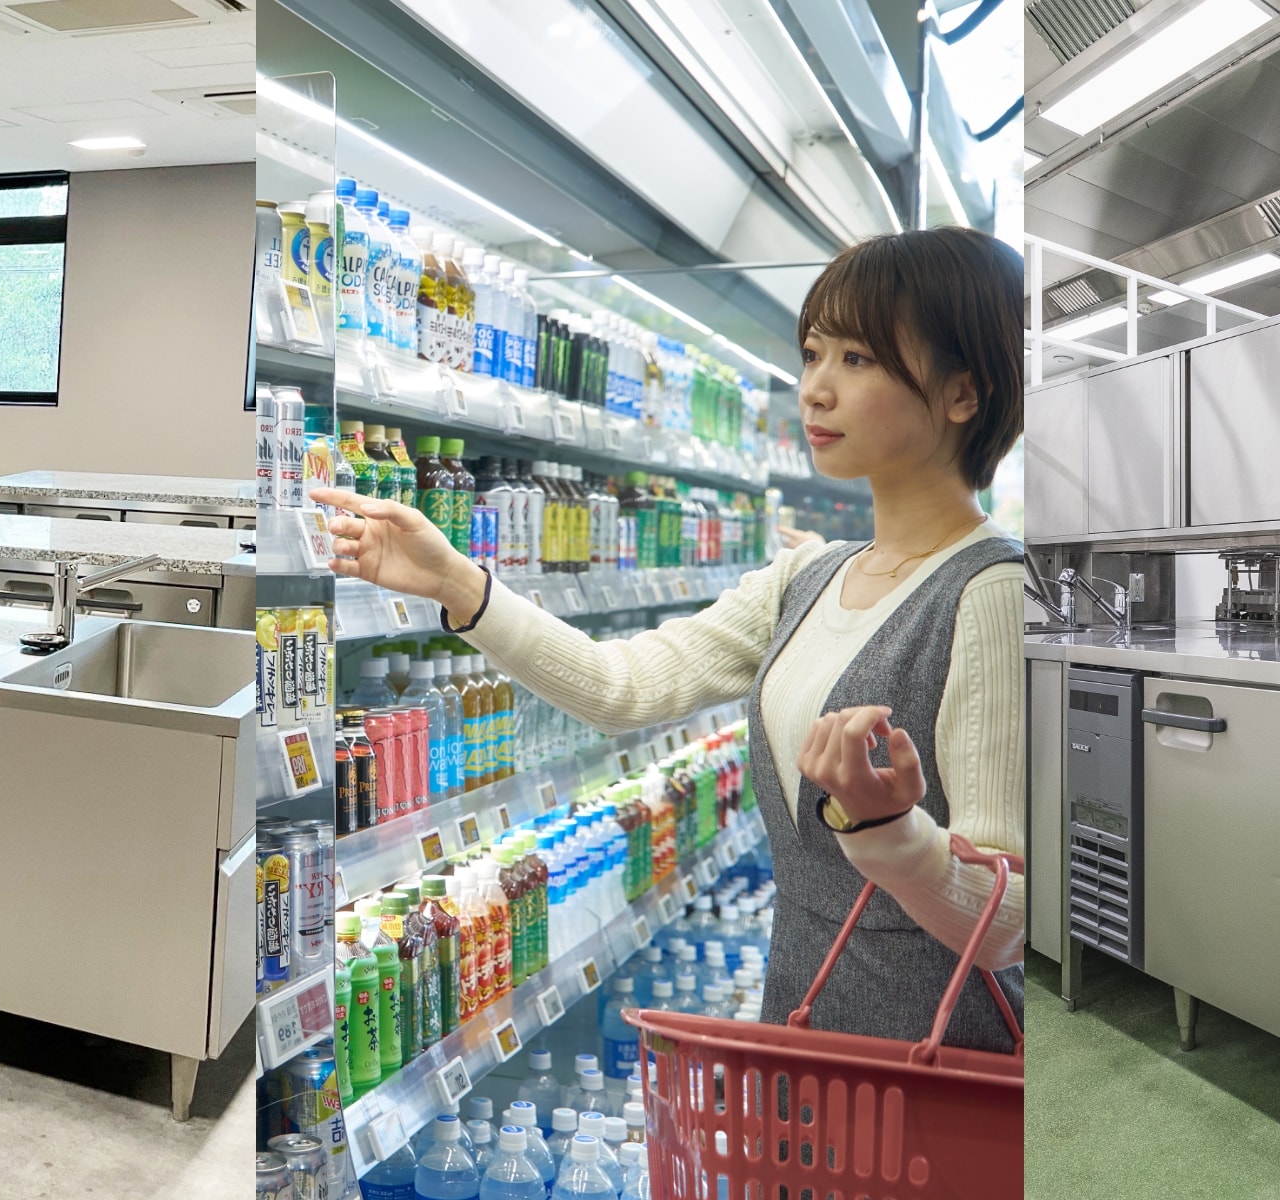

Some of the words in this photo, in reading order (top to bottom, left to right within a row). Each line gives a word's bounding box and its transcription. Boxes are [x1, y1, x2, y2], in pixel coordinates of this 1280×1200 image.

[429, 492, 450, 526] 茶
[452, 493, 469, 526] 茶
[363, 1005, 380, 1052] お茶
